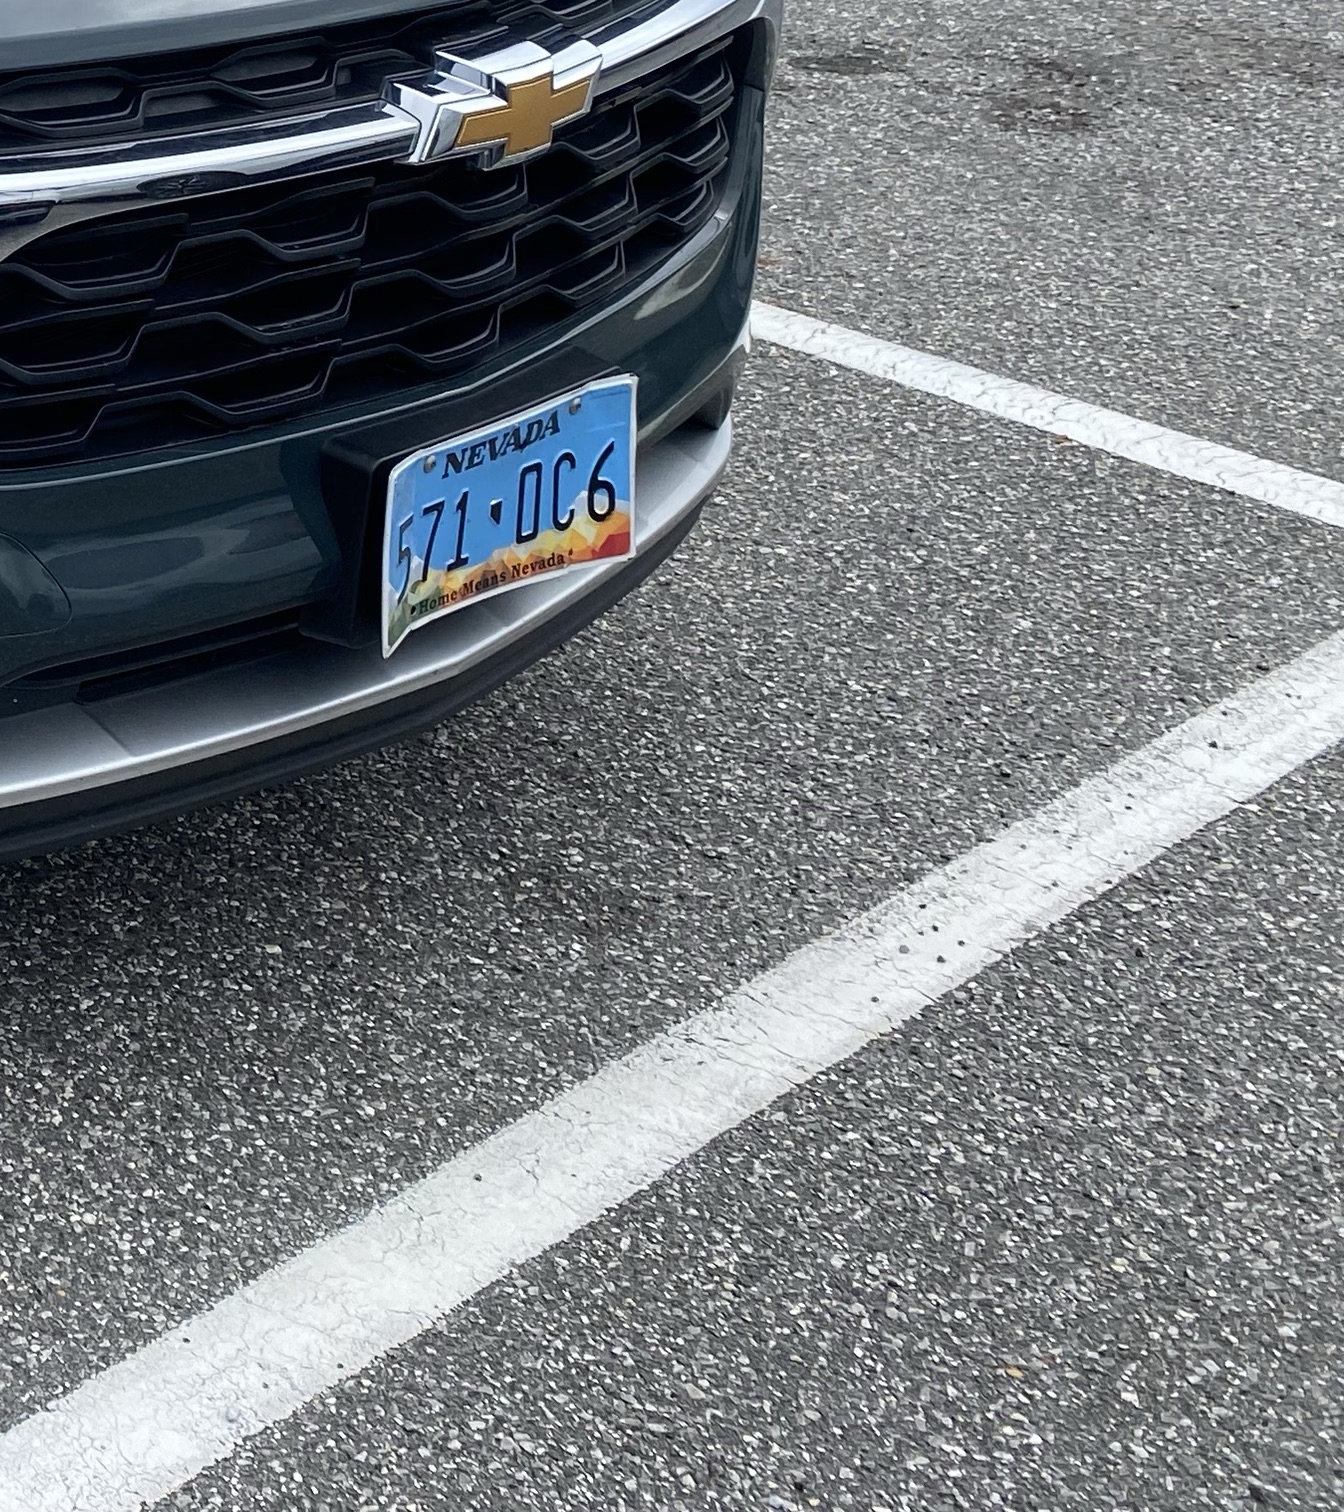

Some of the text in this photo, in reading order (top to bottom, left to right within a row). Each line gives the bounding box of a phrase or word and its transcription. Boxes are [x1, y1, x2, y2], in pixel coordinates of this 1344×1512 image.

[441, 409, 561, 479] NEVADA
[418, 551, 566, 616] Home Means Nevada
